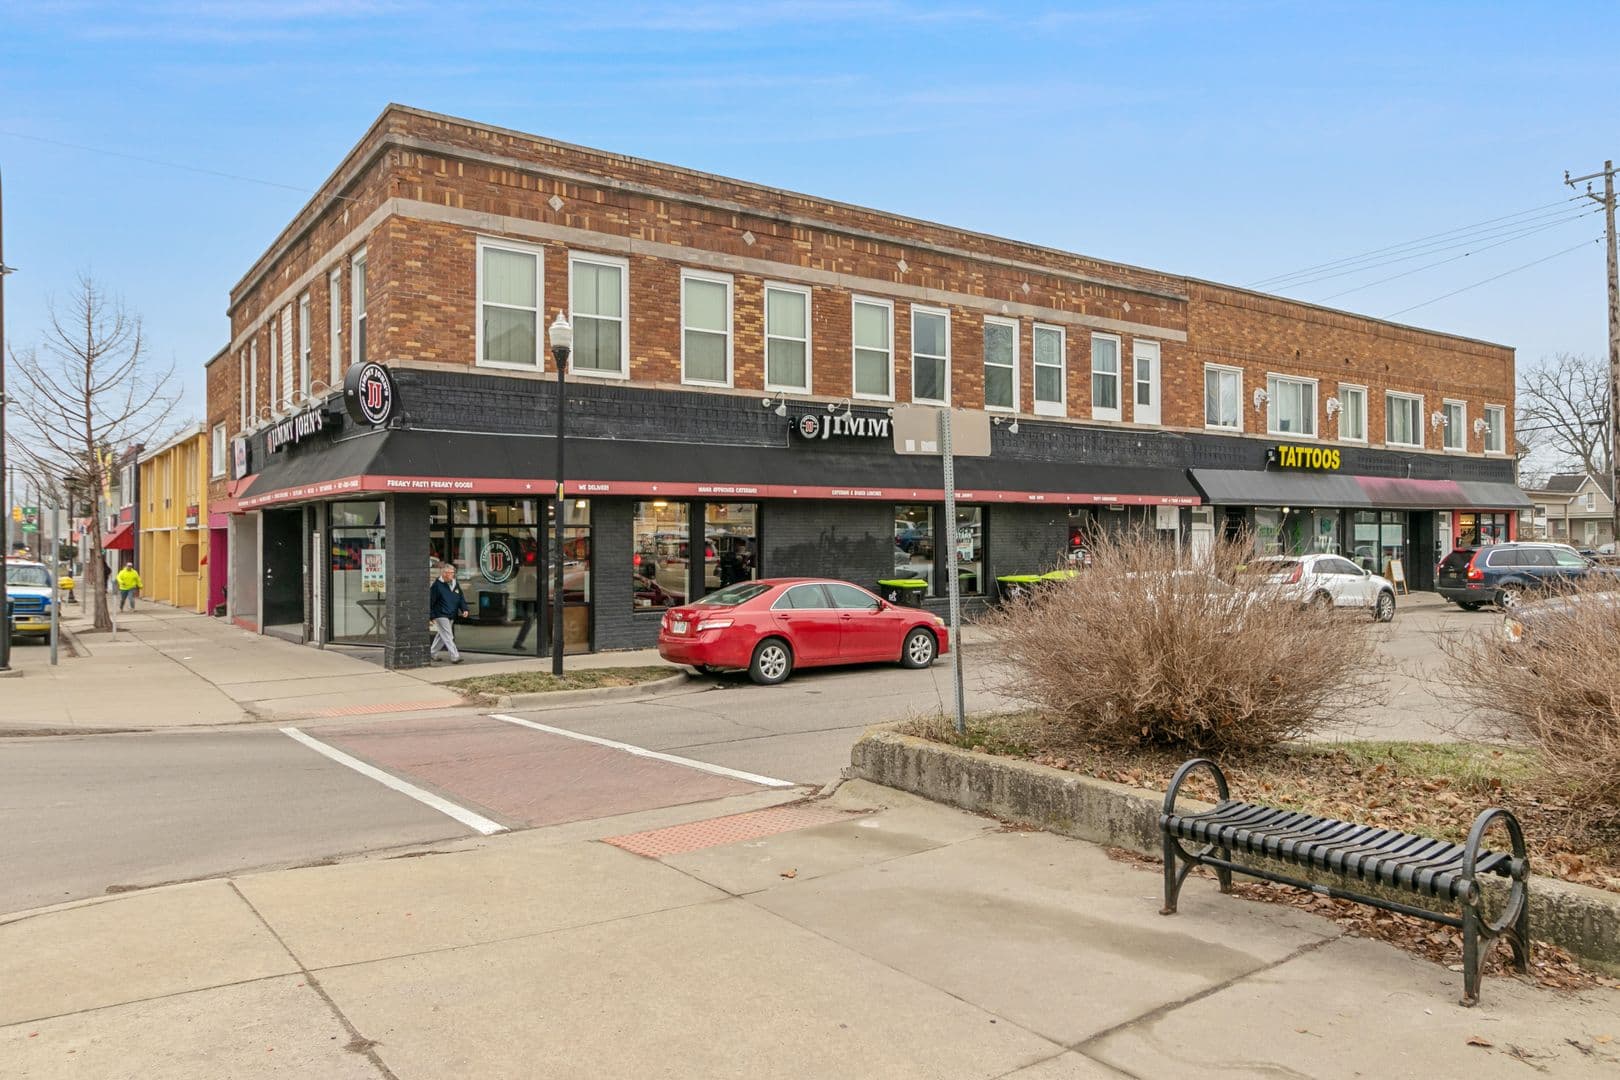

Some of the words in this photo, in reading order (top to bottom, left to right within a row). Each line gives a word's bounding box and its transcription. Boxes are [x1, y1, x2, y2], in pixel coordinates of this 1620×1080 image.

[271, 420, 294, 453] JIMMY
[295, 409, 322, 444] JOHN'S
[822, 415, 895, 439] JIMM
[1278, 445, 1341, 470] TATTOOS
